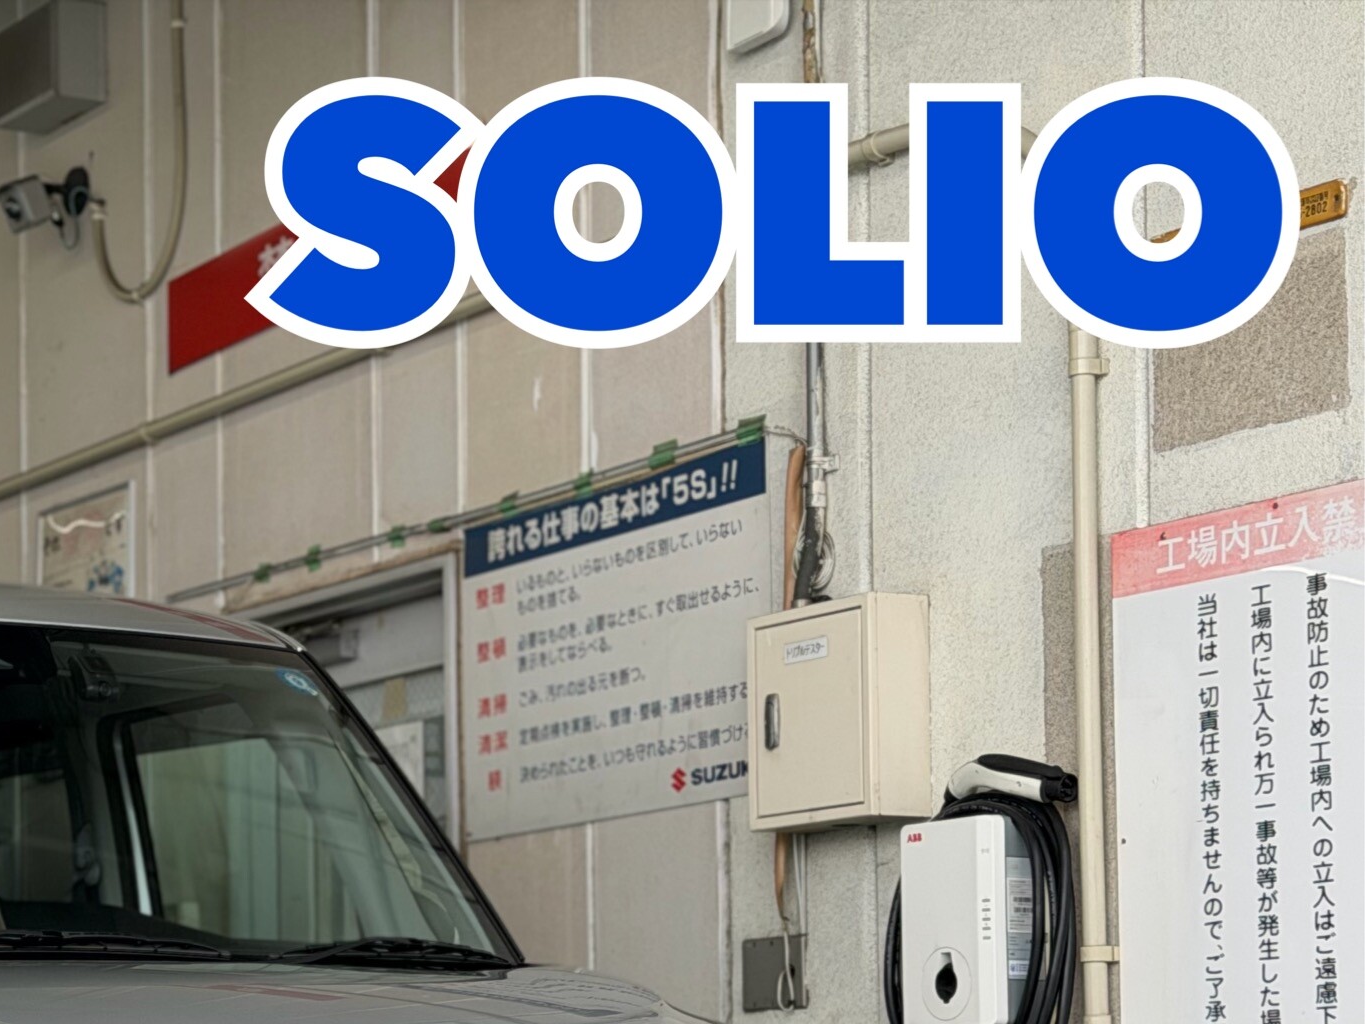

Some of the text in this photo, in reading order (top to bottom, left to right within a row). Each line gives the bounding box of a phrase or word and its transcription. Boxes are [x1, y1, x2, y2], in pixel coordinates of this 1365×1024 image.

[1156, 495, 1362, 575] 工場内立入禁
[690, 760, 748, 786] SUZUK
[907, 832, 922, 843] ABB
